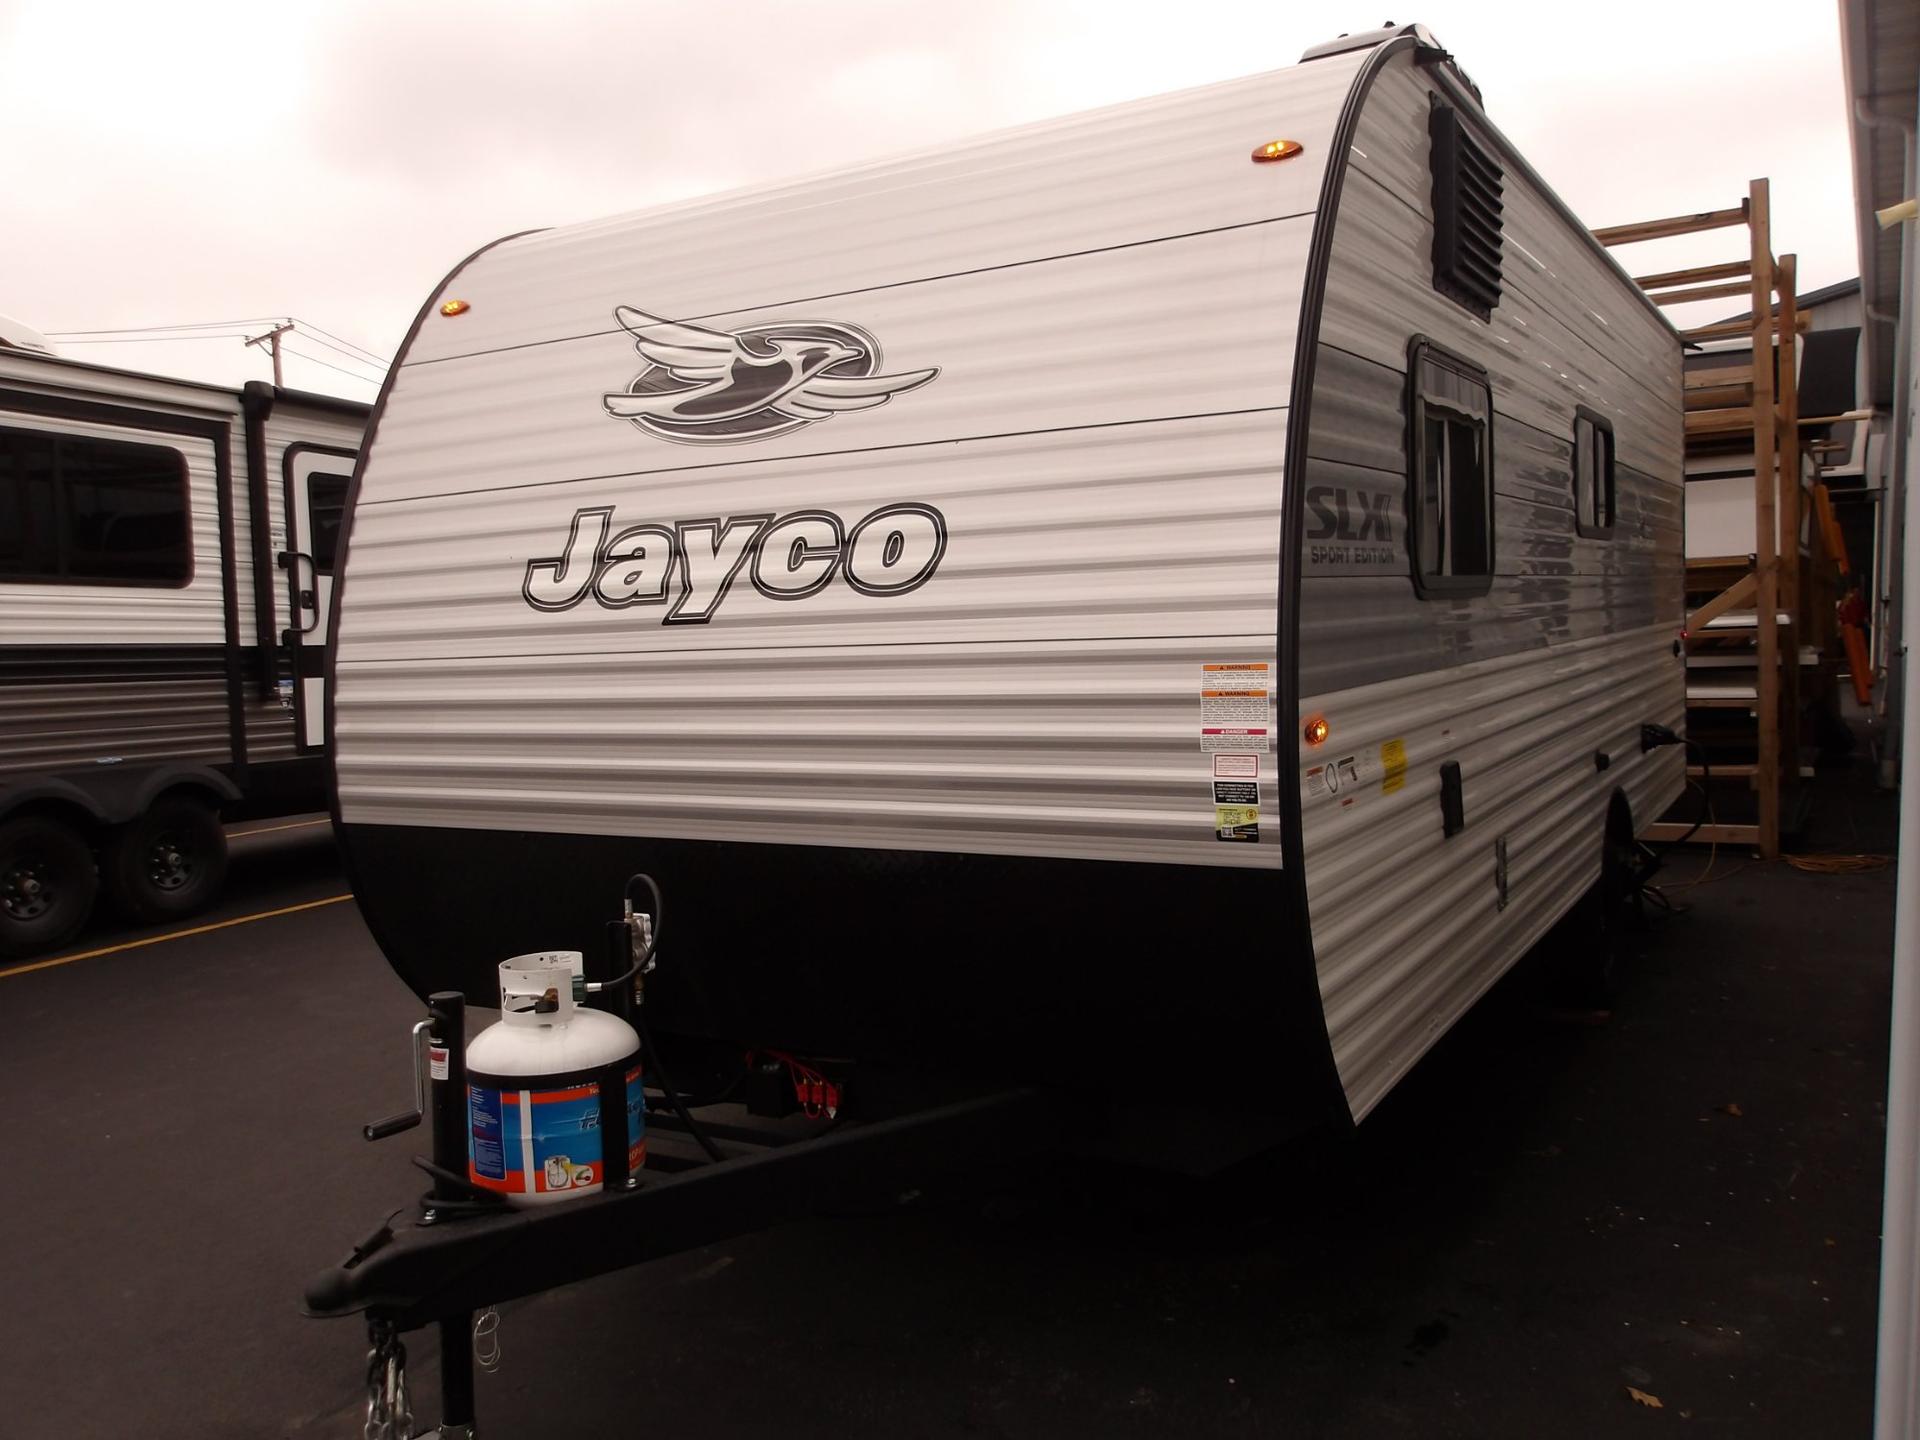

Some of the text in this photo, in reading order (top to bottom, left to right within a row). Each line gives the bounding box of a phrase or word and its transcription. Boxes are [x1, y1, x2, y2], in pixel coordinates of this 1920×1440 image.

[1306, 486, 1393, 542] SLX
[522, 502, 948, 626] Jayco
[1311, 546, 1394, 565] SPORT EDITION
